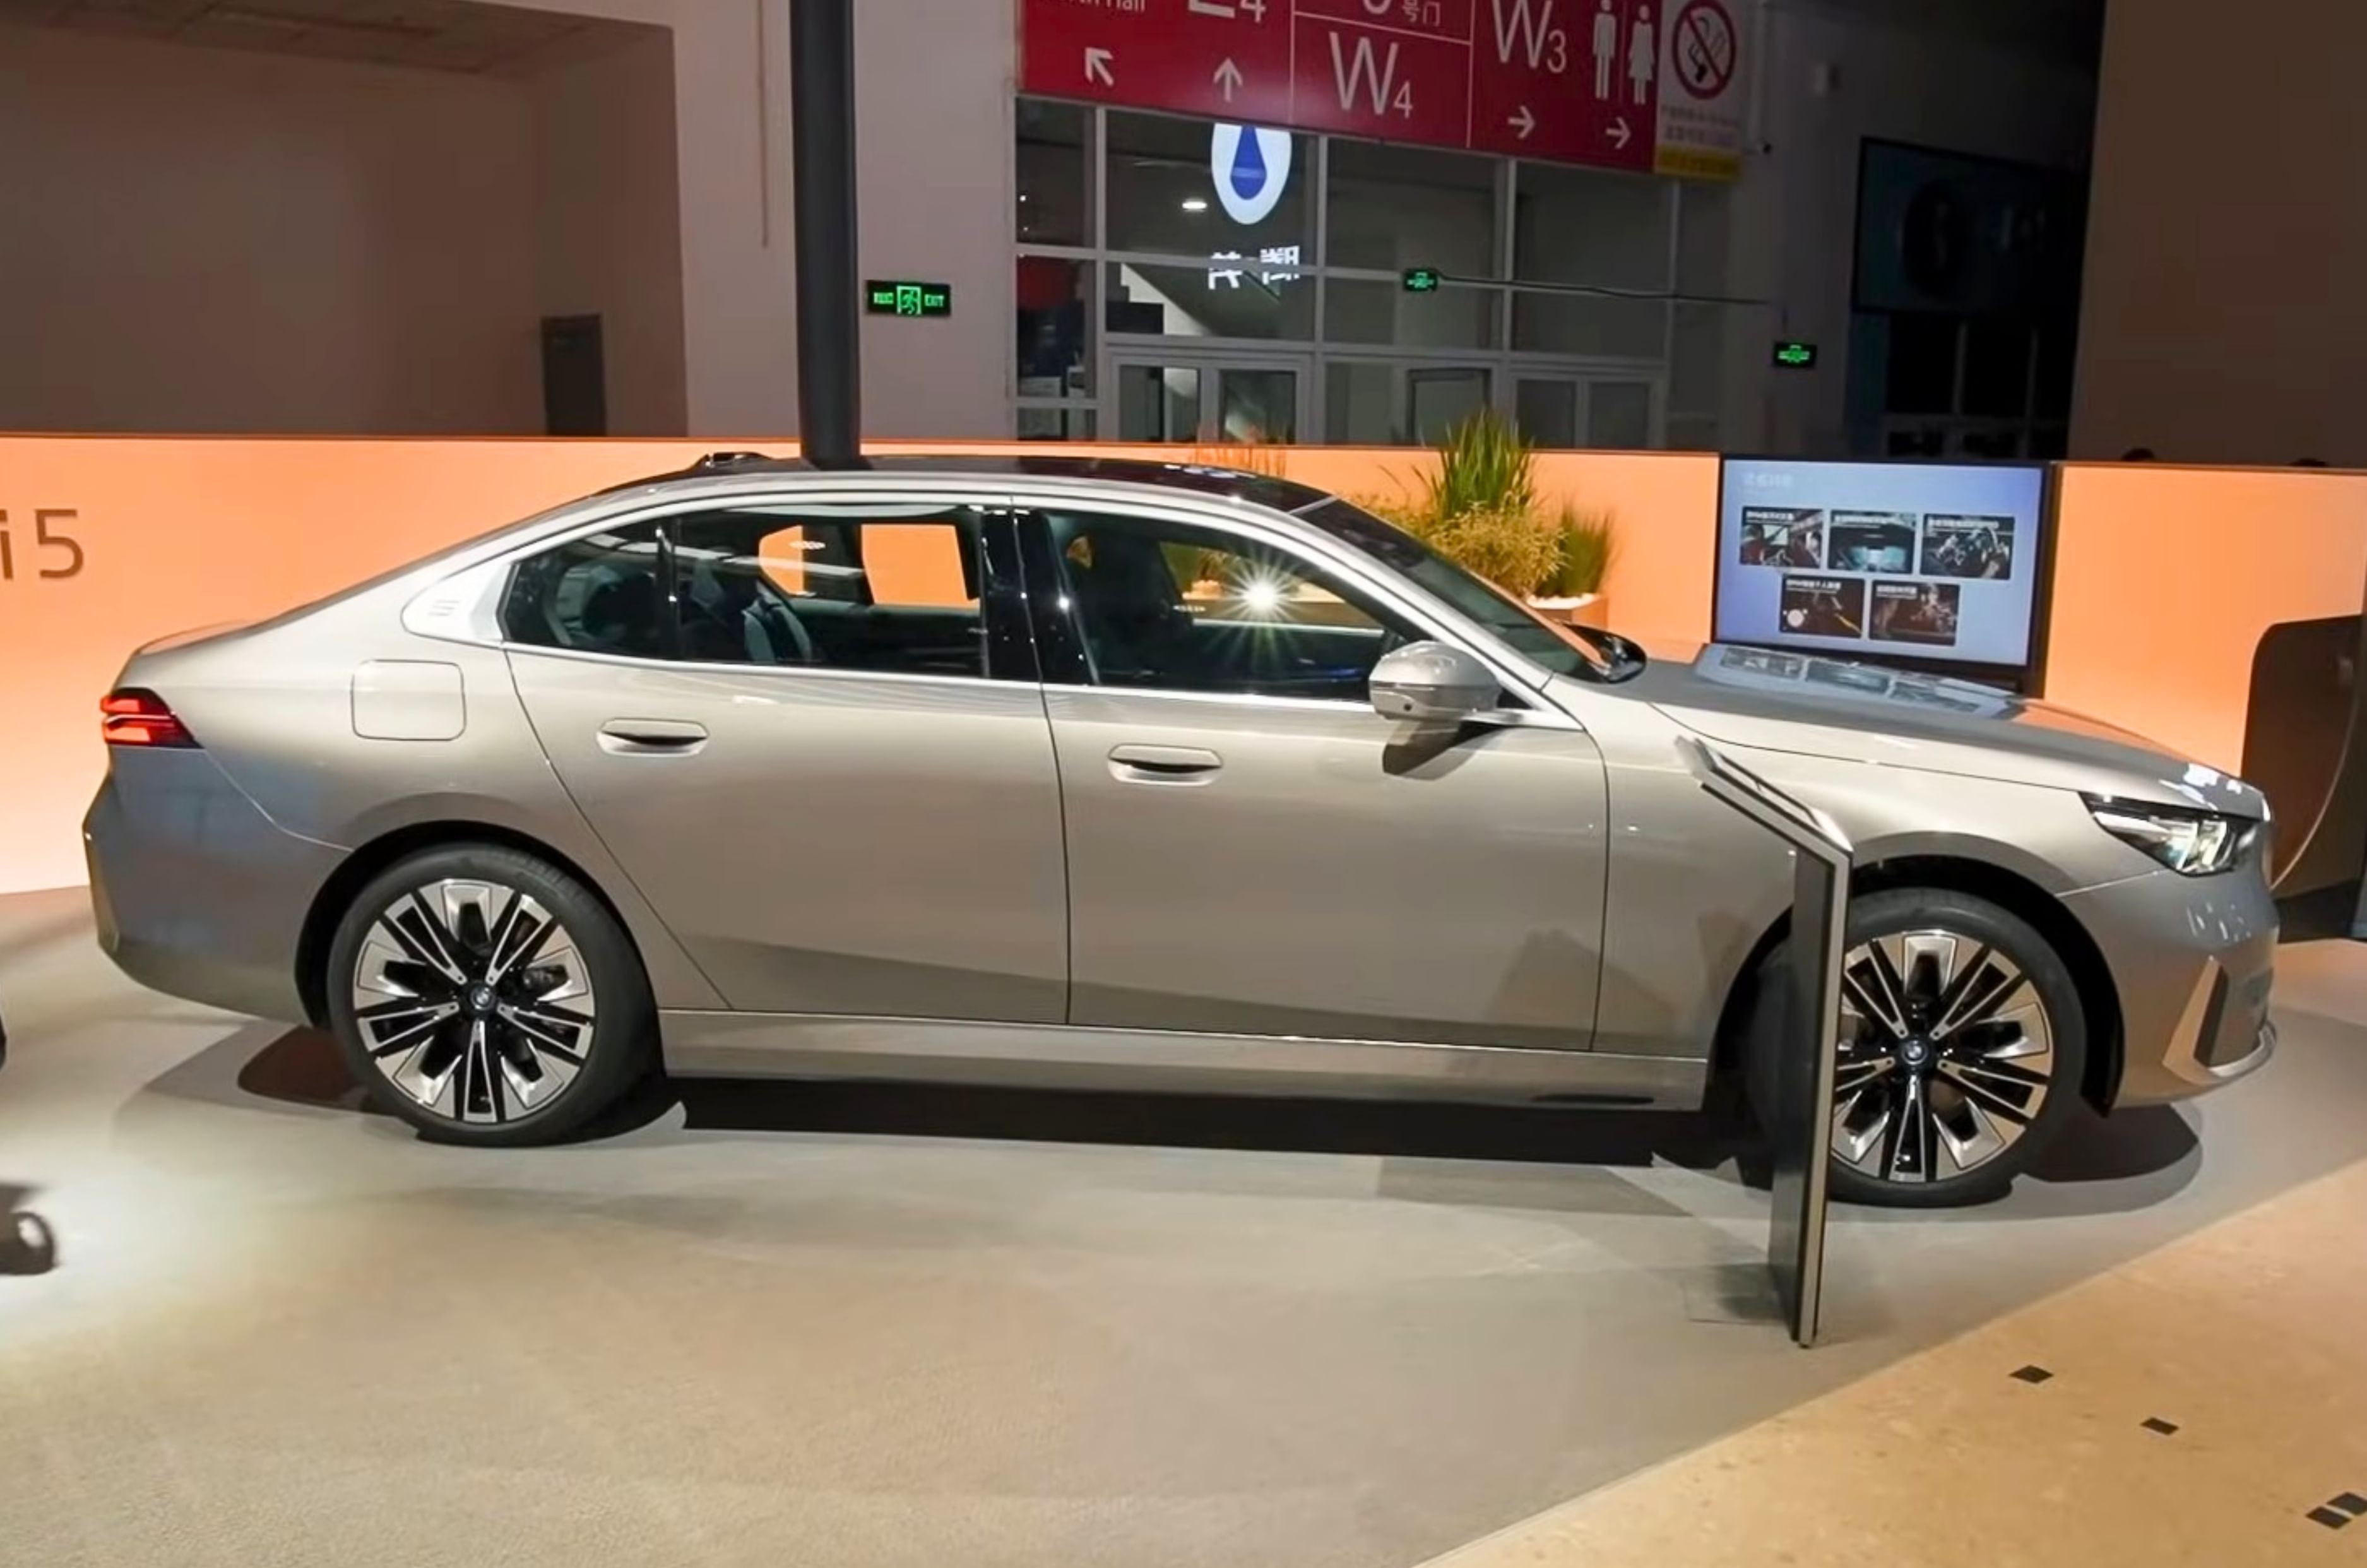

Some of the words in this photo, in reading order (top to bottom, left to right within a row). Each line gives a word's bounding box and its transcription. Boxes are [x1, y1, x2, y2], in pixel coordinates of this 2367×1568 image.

[1493, 0, 1567, 73] W3
[1329, 31, 1414, 119] W4
[0, 509, 84, 581] i5
